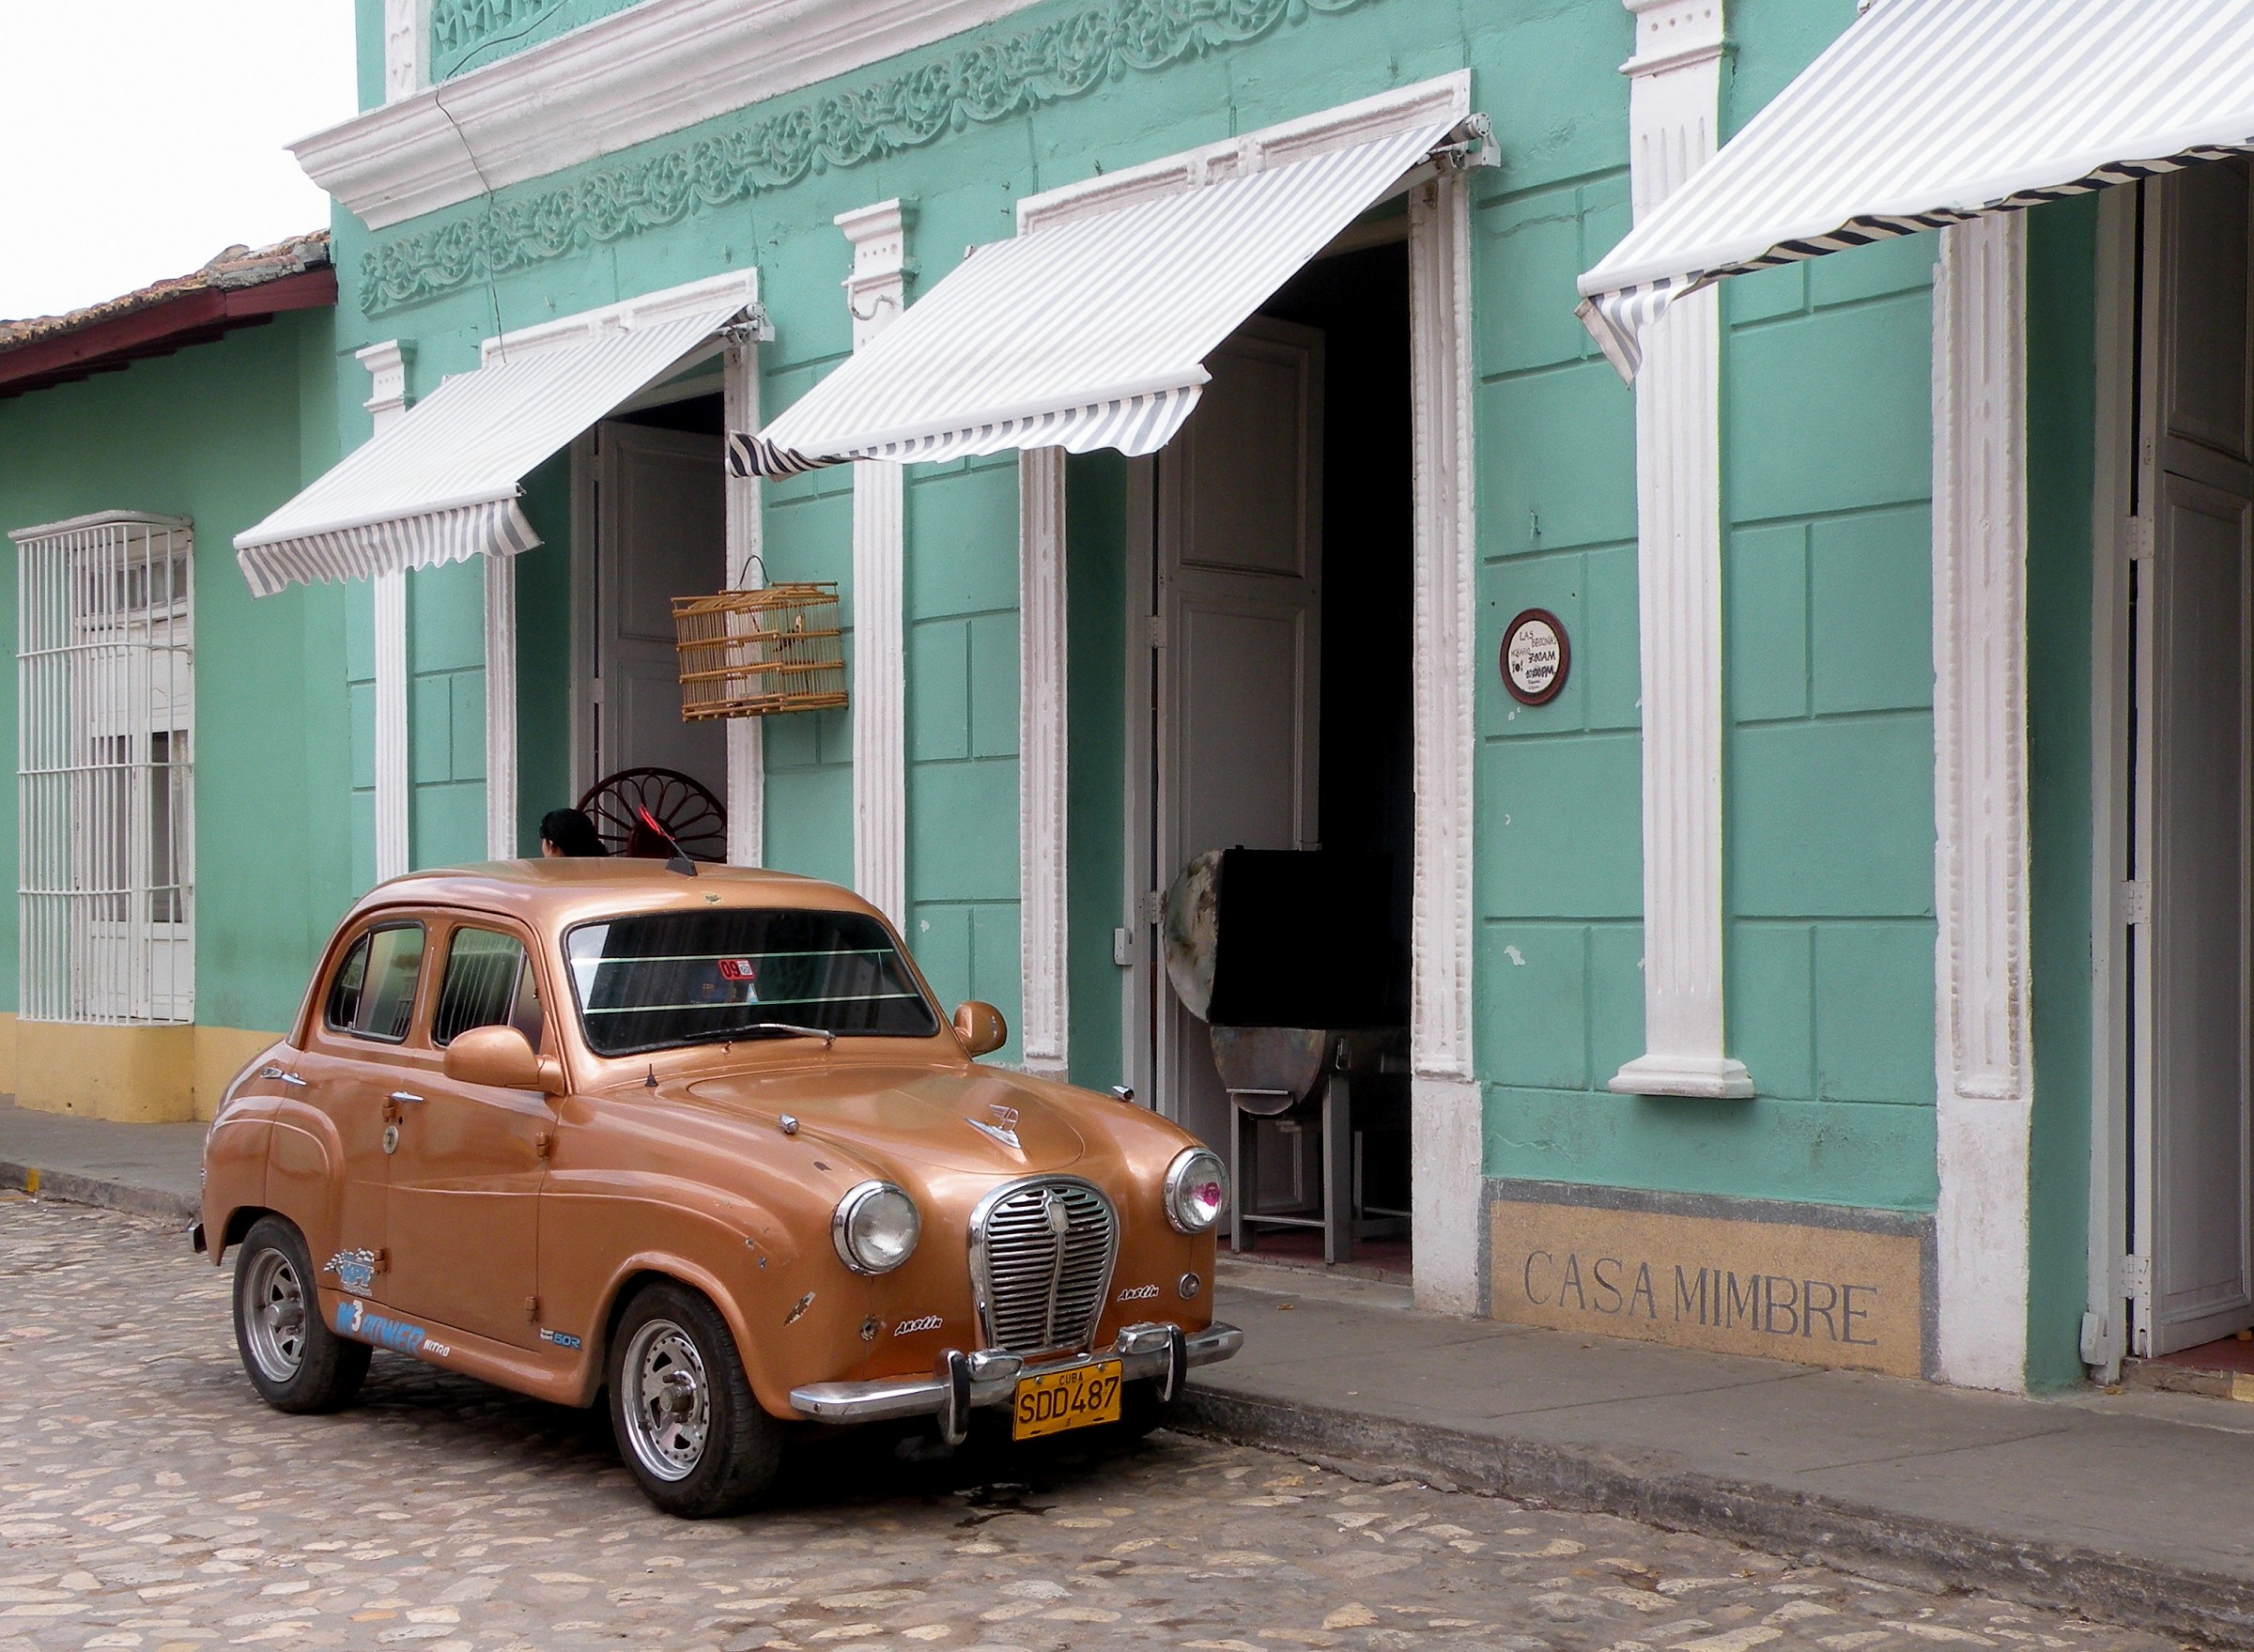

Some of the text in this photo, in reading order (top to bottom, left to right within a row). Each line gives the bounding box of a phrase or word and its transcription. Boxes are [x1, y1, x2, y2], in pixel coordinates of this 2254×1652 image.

[1519, 630, 1534, 641] LAS
[720, 961, 741, 978] 09
[1524, 1250, 1878, 1346] CASA MIMBRE
[423, 1338, 451, 1357] NITRO
[1058, 1371, 1084, 1385] CUBA
